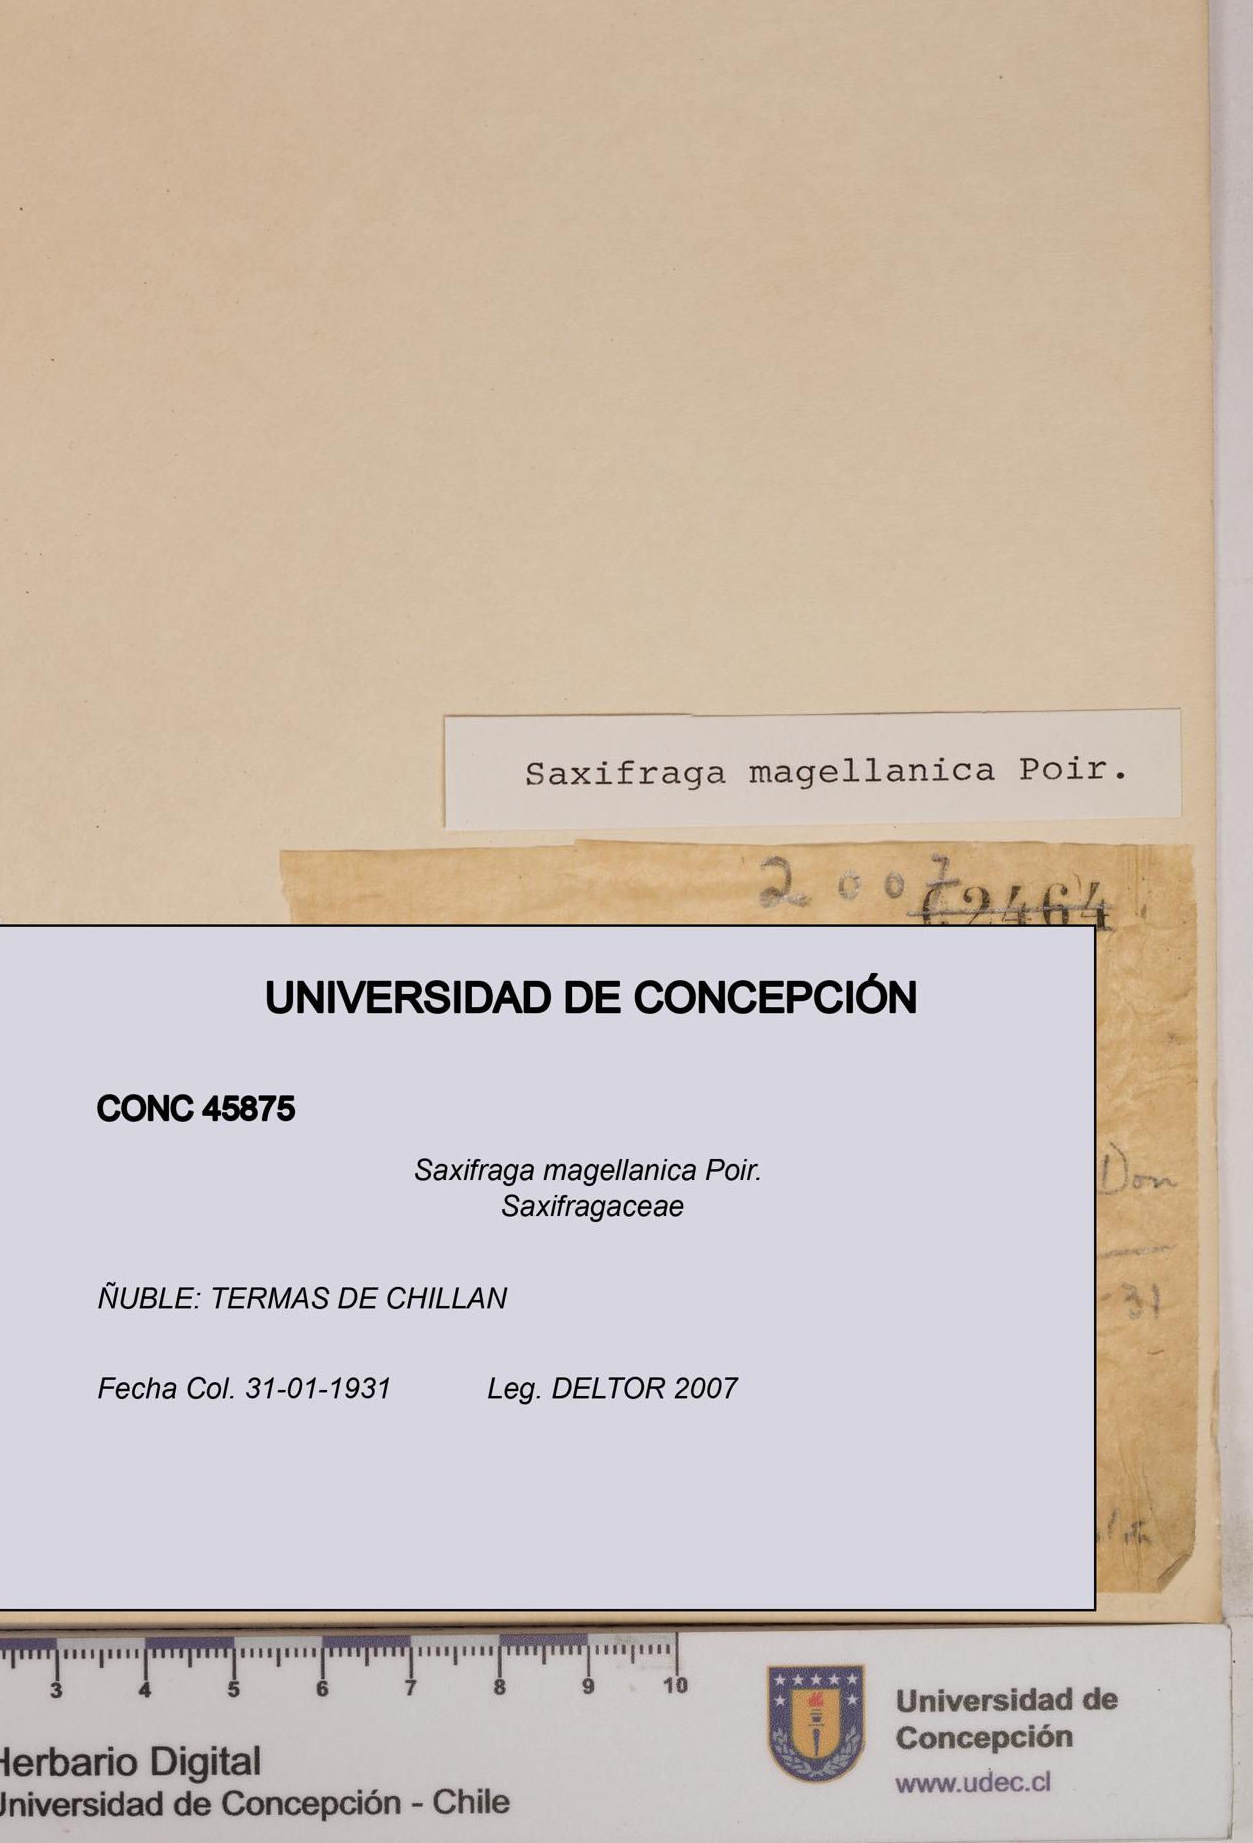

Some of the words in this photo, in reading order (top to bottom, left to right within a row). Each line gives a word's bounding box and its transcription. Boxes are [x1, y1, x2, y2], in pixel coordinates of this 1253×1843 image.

[527, 761, 725, 790] Saxifraga
[750, 758, 995, 789] magellanica
[1020, 756, 1124, 779] Poir.
[51, 1682, 62, 1698] 3
[139, 1682, 151, 1698] 4
[228, 1681, 239, 1697] 5
[317, 1681, 328, 1696] 6
[405, 1680, 417, 1695] 7
[494, 1679, 506, 1695] 8
[582, 1678, 594, 1694] 9
[664, 1677, 687, 1693] 10
[898, 1688, 1072, 1712] Universidad
[1083, 1687, 1118, 1710] de
[896, 1724, 1072, 1754] Concepción
[152, 1746, 260, 1782] Digital
[896, 1771, 1050, 1793] www.udec.cl
[174, 1791, 211, 1816] de
[222, 1790, 400, 1821] Concepción
[434, 1788, 510, 1814] Chile
